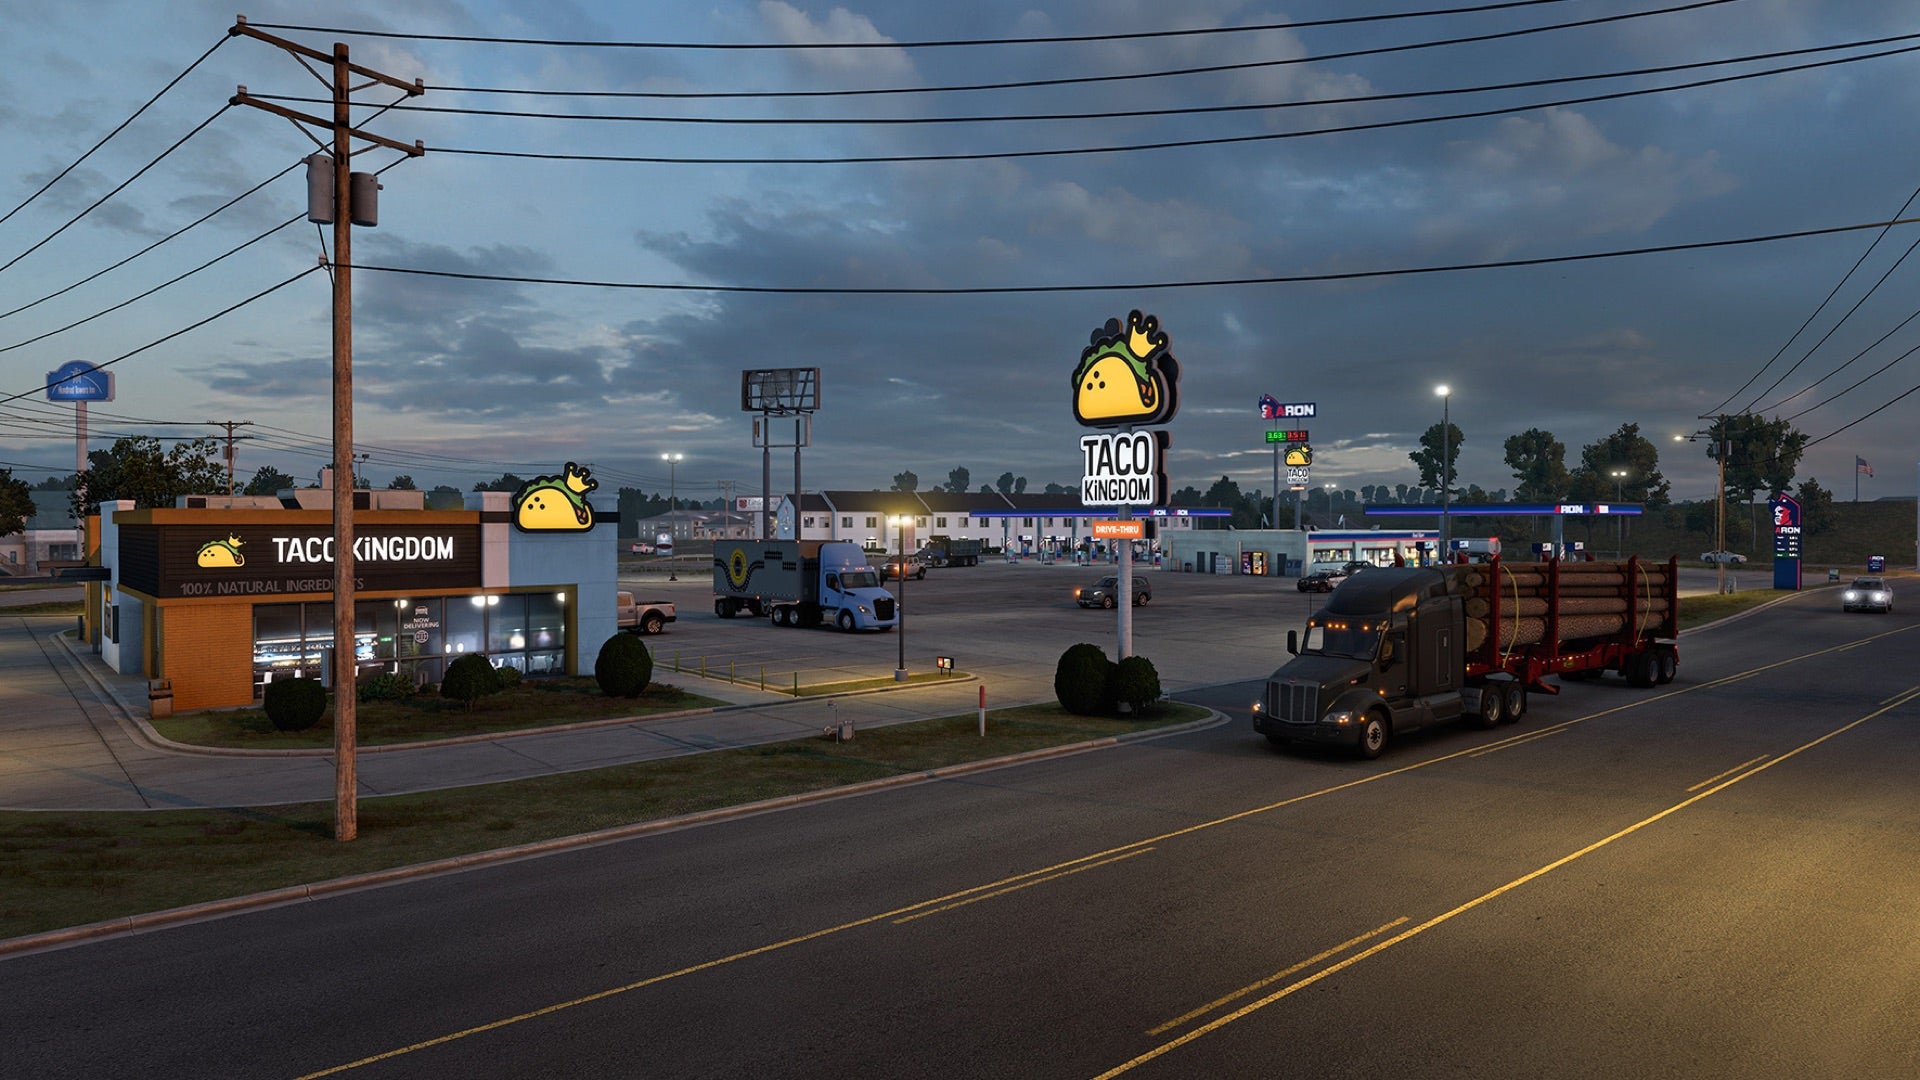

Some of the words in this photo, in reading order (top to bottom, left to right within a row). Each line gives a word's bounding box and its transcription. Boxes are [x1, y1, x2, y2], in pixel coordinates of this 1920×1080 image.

[1276, 404, 1314, 417] ARON
[1083, 435, 1150, 477] TACO
[1287, 468, 1308, 478] TACO
[1095, 525, 1139, 534] DRIVE-THRU
[1775, 526, 1801, 535] ARON
[180, 582, 214, 595] 100%
[217, 580, 282, 594] NATURAL
[403, 621, 440, 629] DELIVERING
